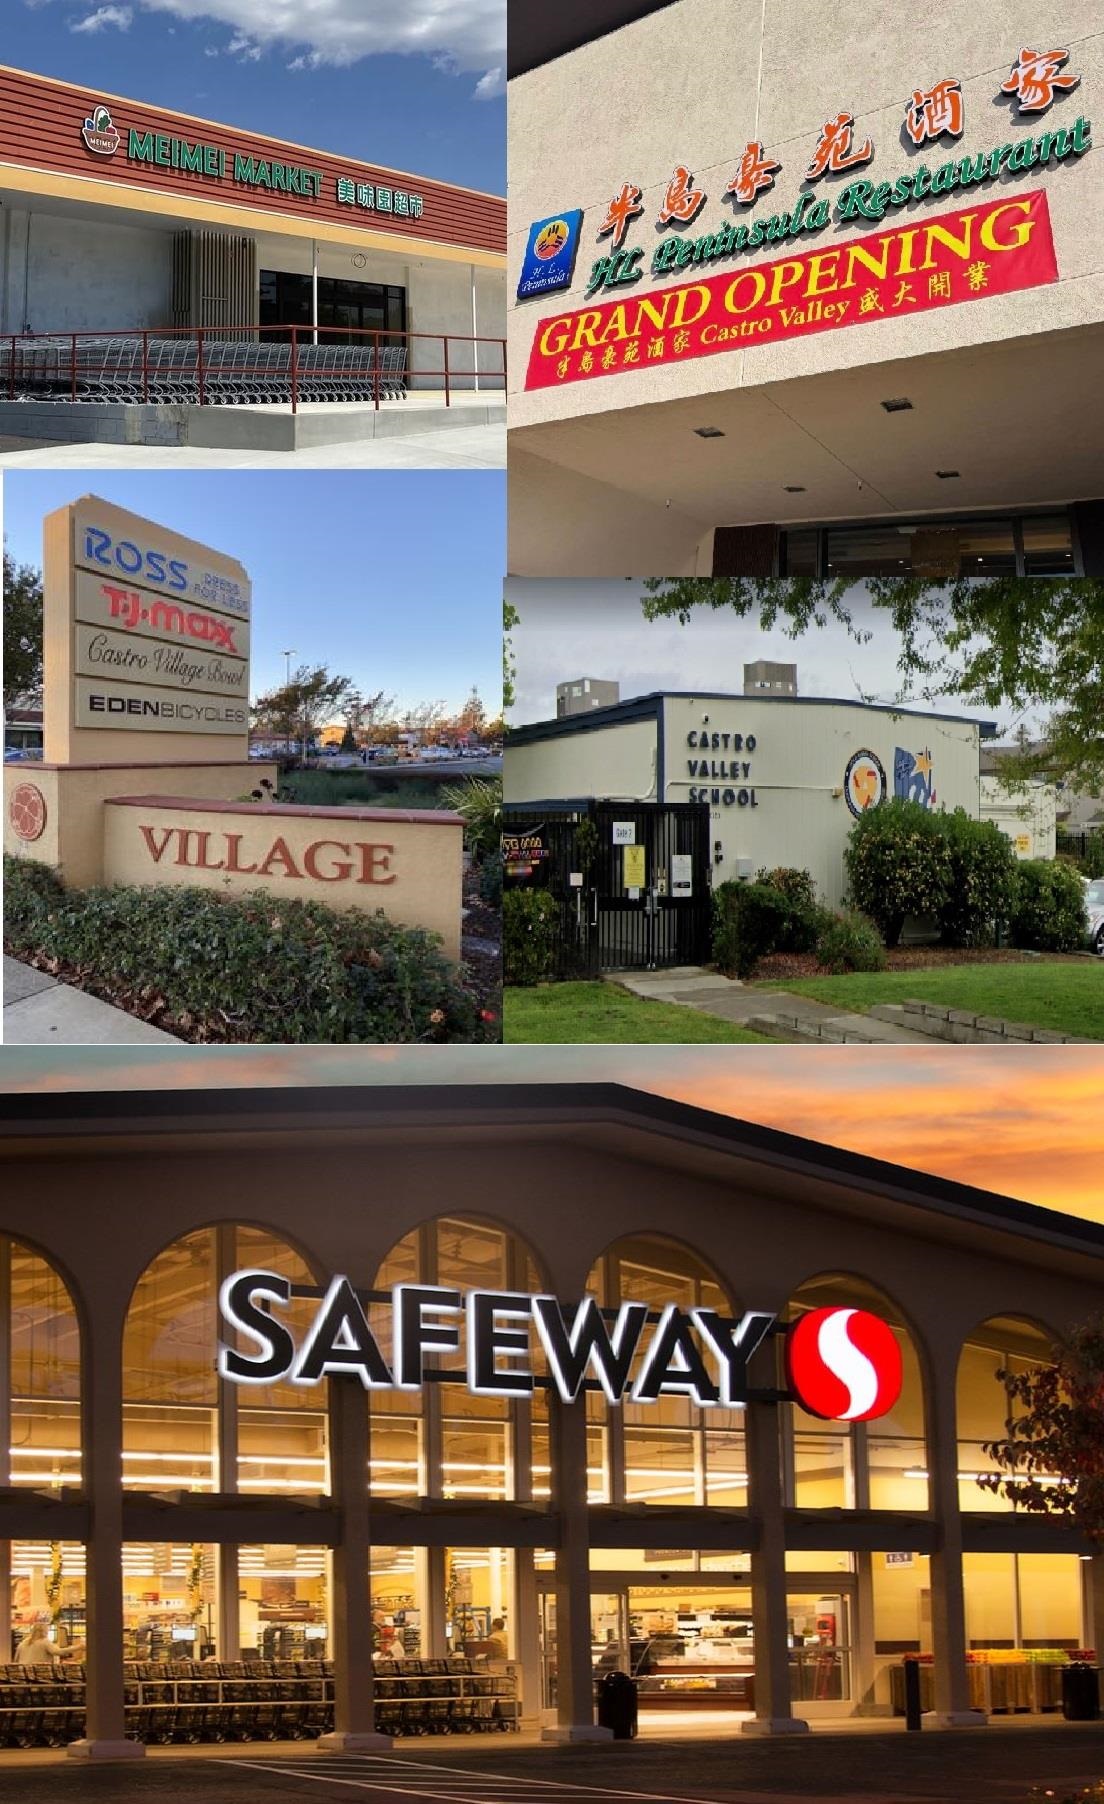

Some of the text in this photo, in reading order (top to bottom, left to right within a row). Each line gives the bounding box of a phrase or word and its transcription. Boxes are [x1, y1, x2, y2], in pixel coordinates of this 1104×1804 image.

[89, 137, 114, 149] MEIMEI
[128, 128, 324, 197] MEIMEI MARKET
[337, 178, 424, 218] 美味園超市
[586, 114, 1093, 292] HL Peninsula Restaurant
[539, 200, 1037, 357] GRAND OPENING
[859, 260, 992, 316] 盛大開業
[700, 300, 851, 346] Castro Valley
[85, 526, 189, 591] ROSS
[88, 632, 246, 686] Castro Village Bowl
[687, 730, 757, 752] CASTRO
[687, 760, 752, 779] VALLEY
[688, 786, 759, 808] SCHOOL
[138, 824, 398, 886] VILLAGE
[218, 1269, 776, 1408] SAFEWAY
